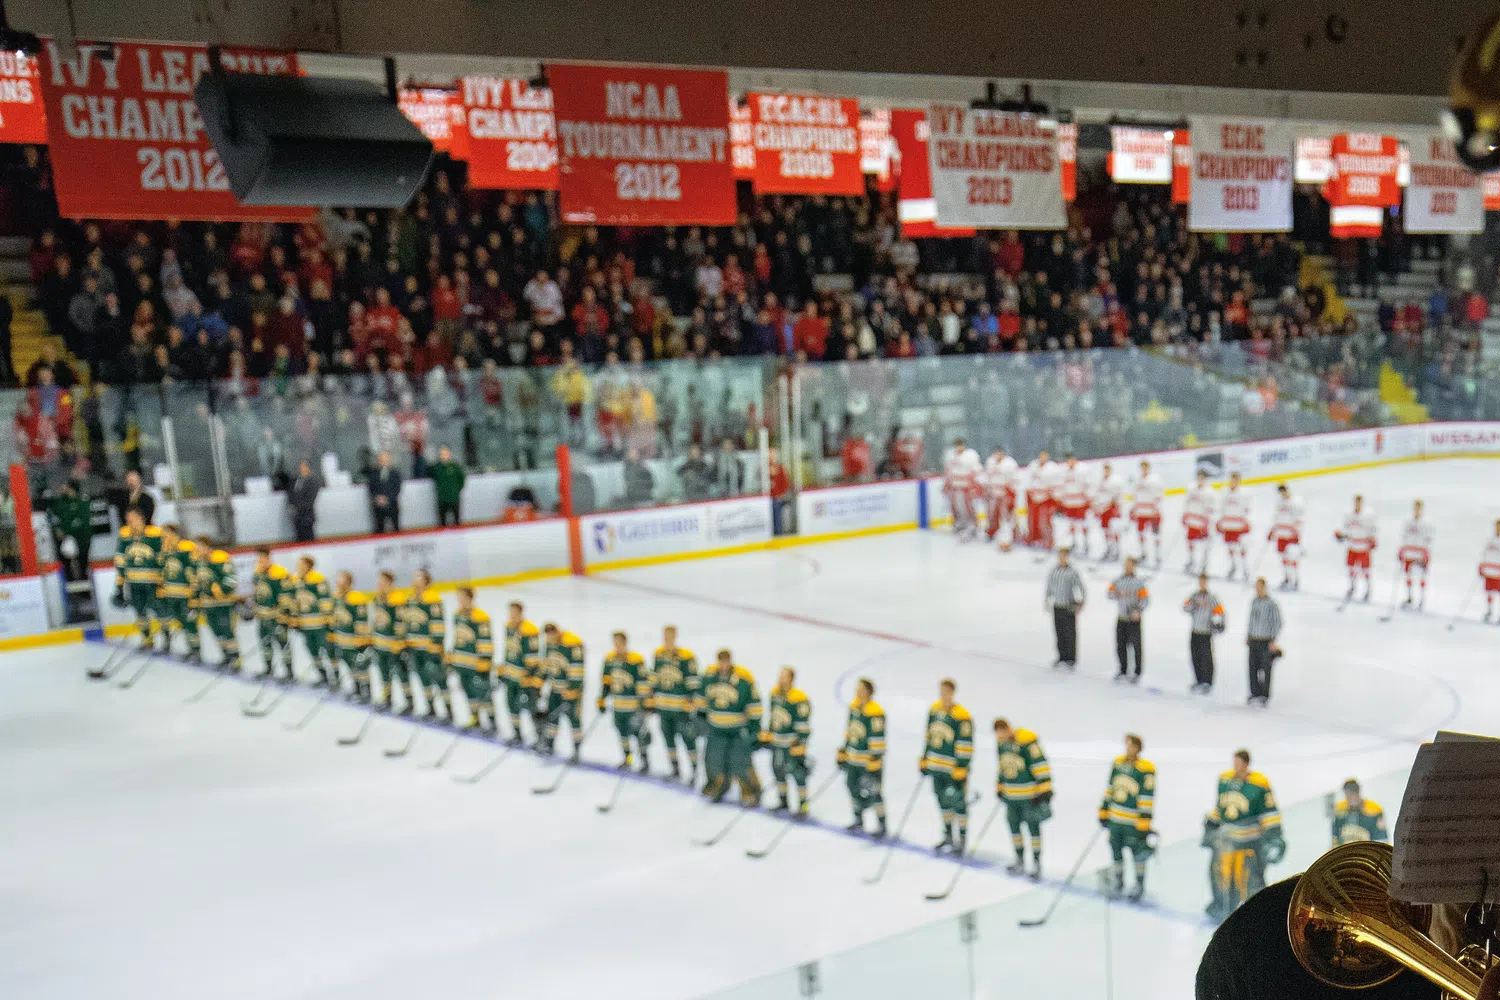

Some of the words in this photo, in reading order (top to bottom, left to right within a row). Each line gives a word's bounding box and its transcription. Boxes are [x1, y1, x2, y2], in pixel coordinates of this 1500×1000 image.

[48, 42, 120, 89] IVY
[606, 81, 682, 121] NCAA
[559, 120, 727, 163] TOURNAMENT
[754, 122, 858, 154] CHAMPIONS
[935, 137, 1053, 174] CHAMPIONS
[138, 148, 231, 191] 2012
[616, 162, 682, 199] 2012
